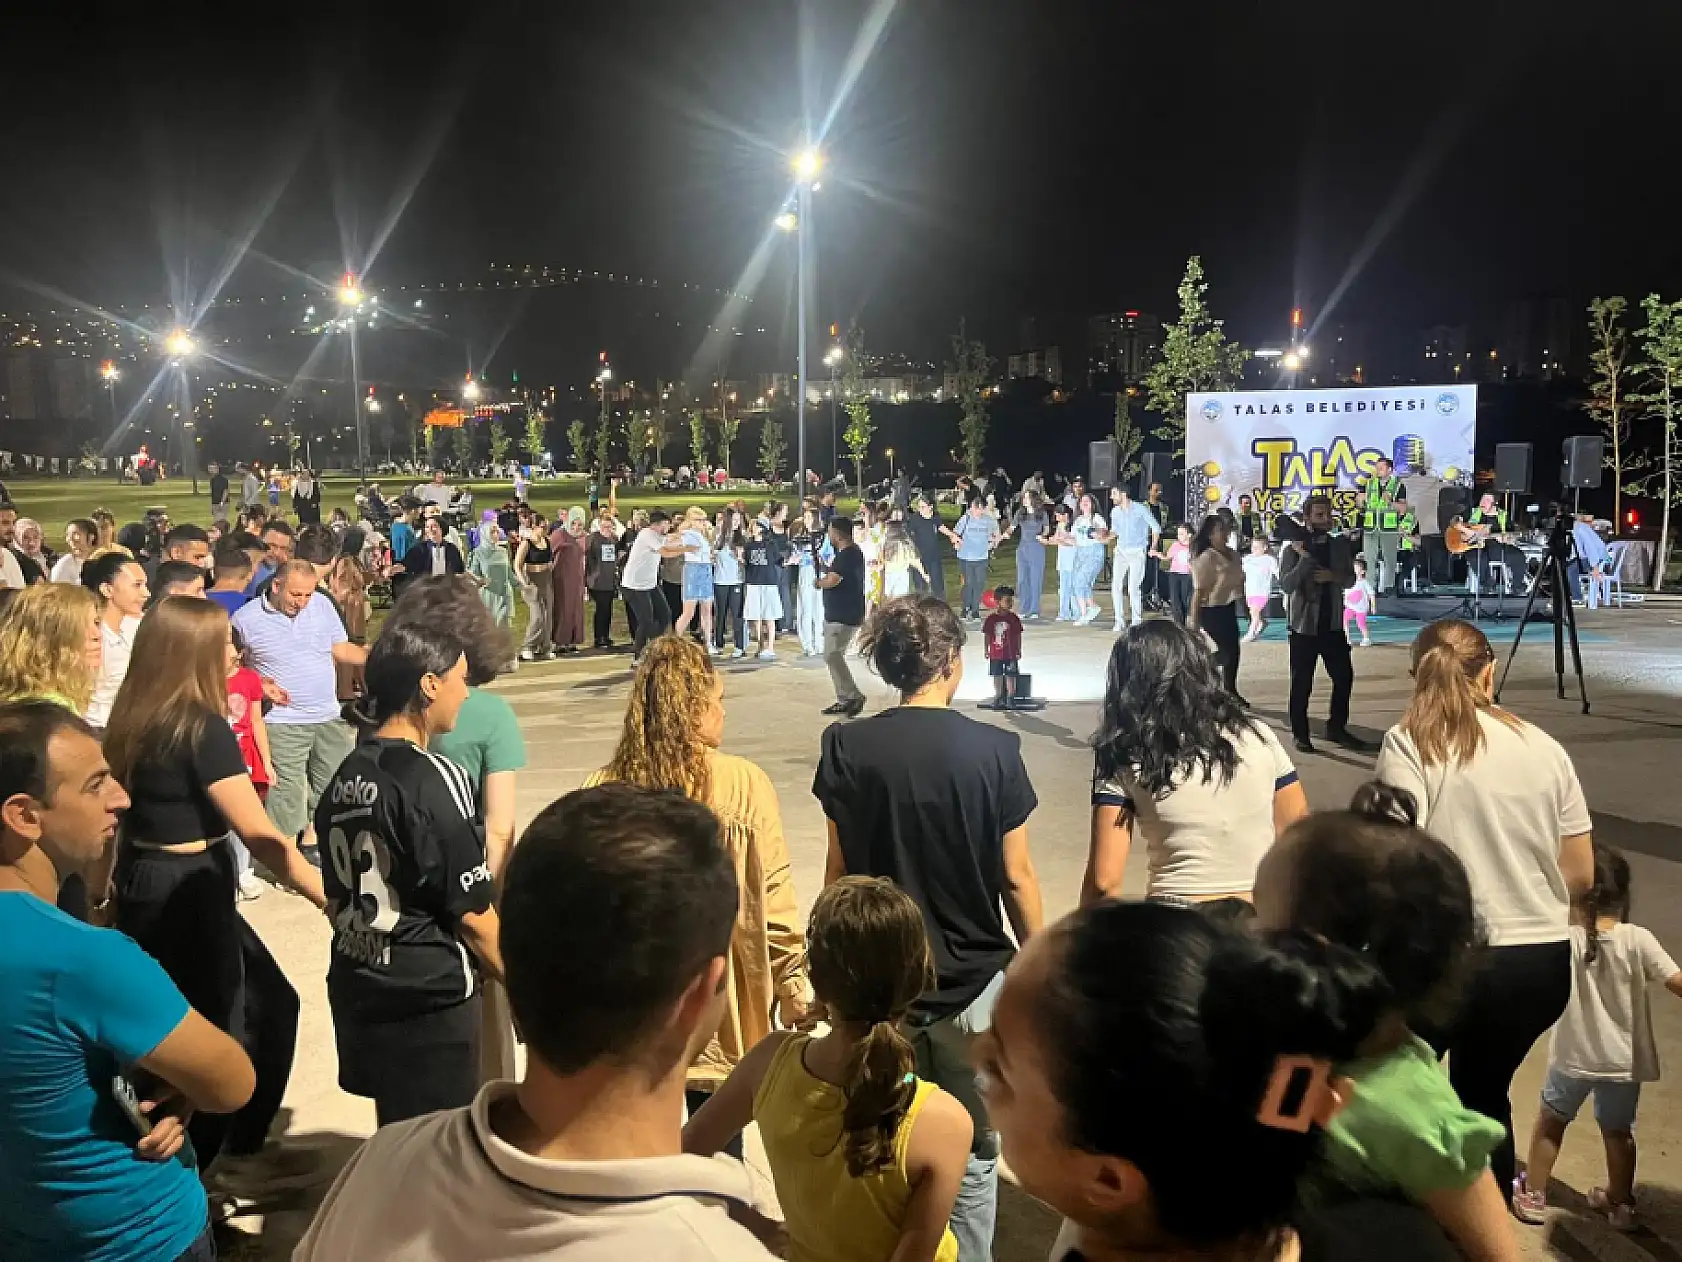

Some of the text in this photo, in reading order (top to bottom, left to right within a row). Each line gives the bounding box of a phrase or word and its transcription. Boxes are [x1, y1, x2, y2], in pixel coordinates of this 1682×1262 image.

[1233, 404, 1295, 416] TALAS
[1254, 488, 1302, 512] Yaz
[332, 774, 378, 806] beko
